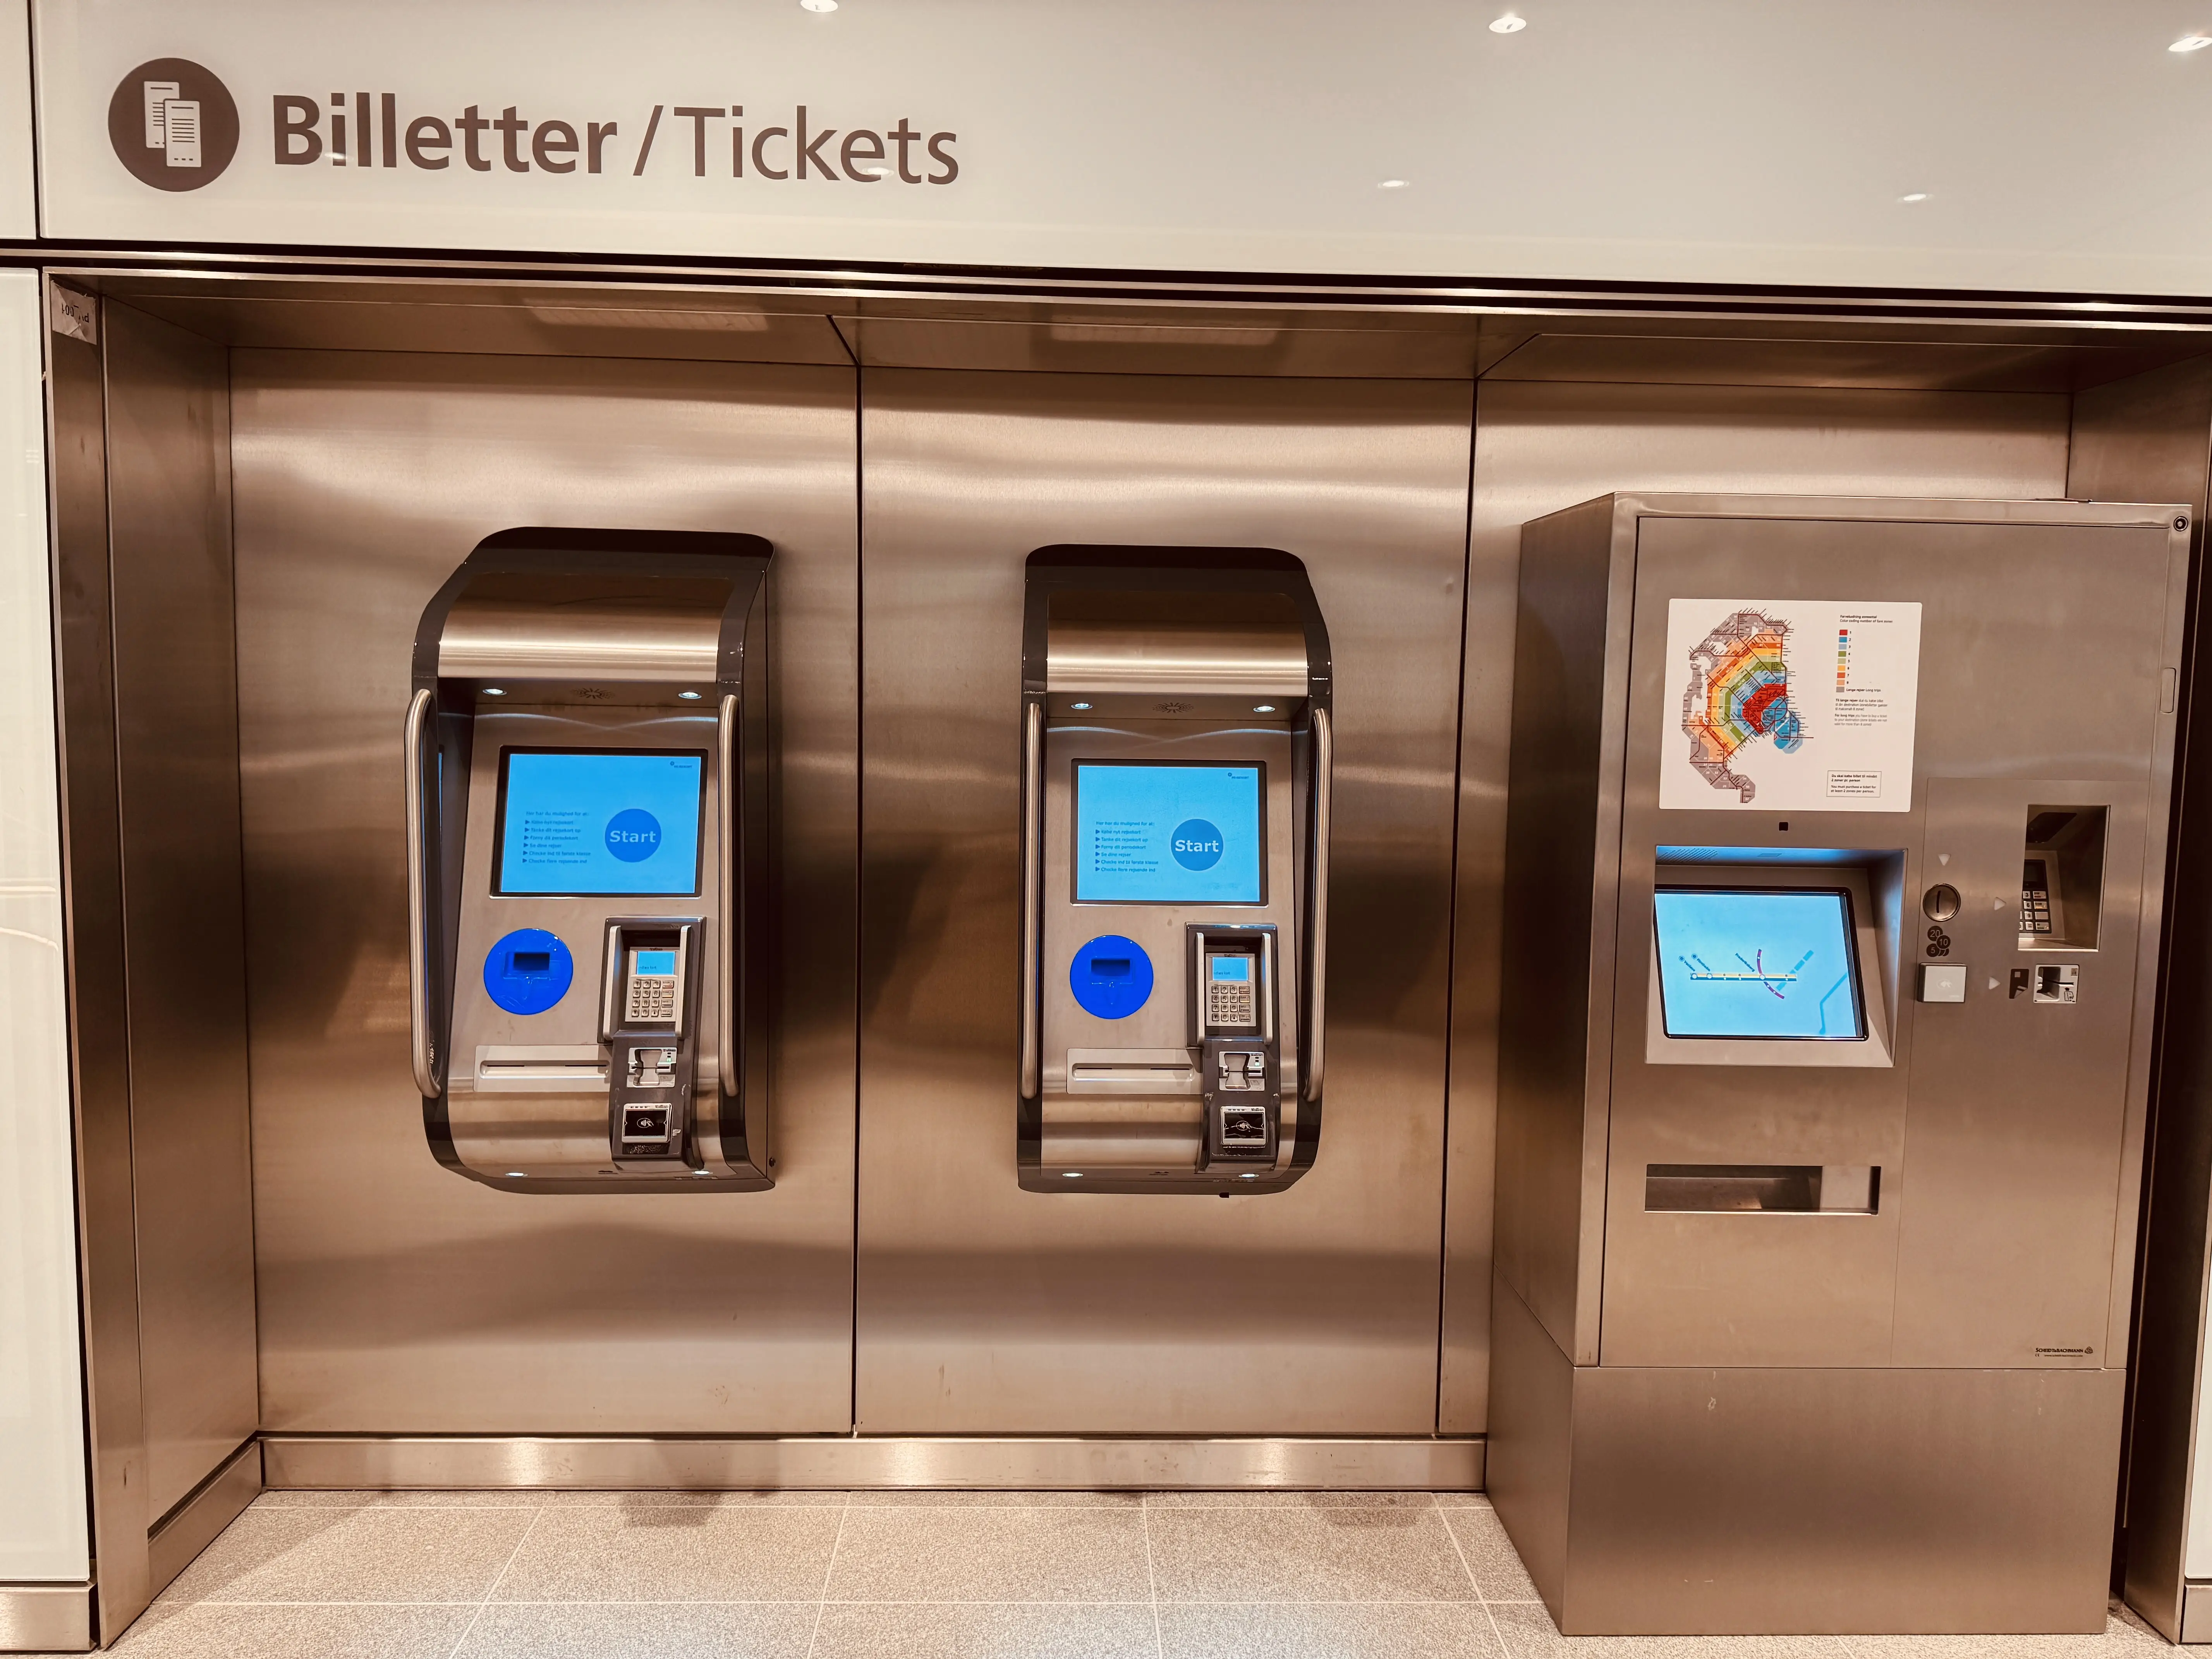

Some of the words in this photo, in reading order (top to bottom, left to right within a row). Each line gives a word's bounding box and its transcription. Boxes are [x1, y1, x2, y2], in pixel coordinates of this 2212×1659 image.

[273, 92, 618, 174] Billetter
[632, 105, 664, 176] /
[673, 105, 959, 185] Tickets
[610, 830, 656, 843] Start
[1175, 839, 1219, 852] Start
